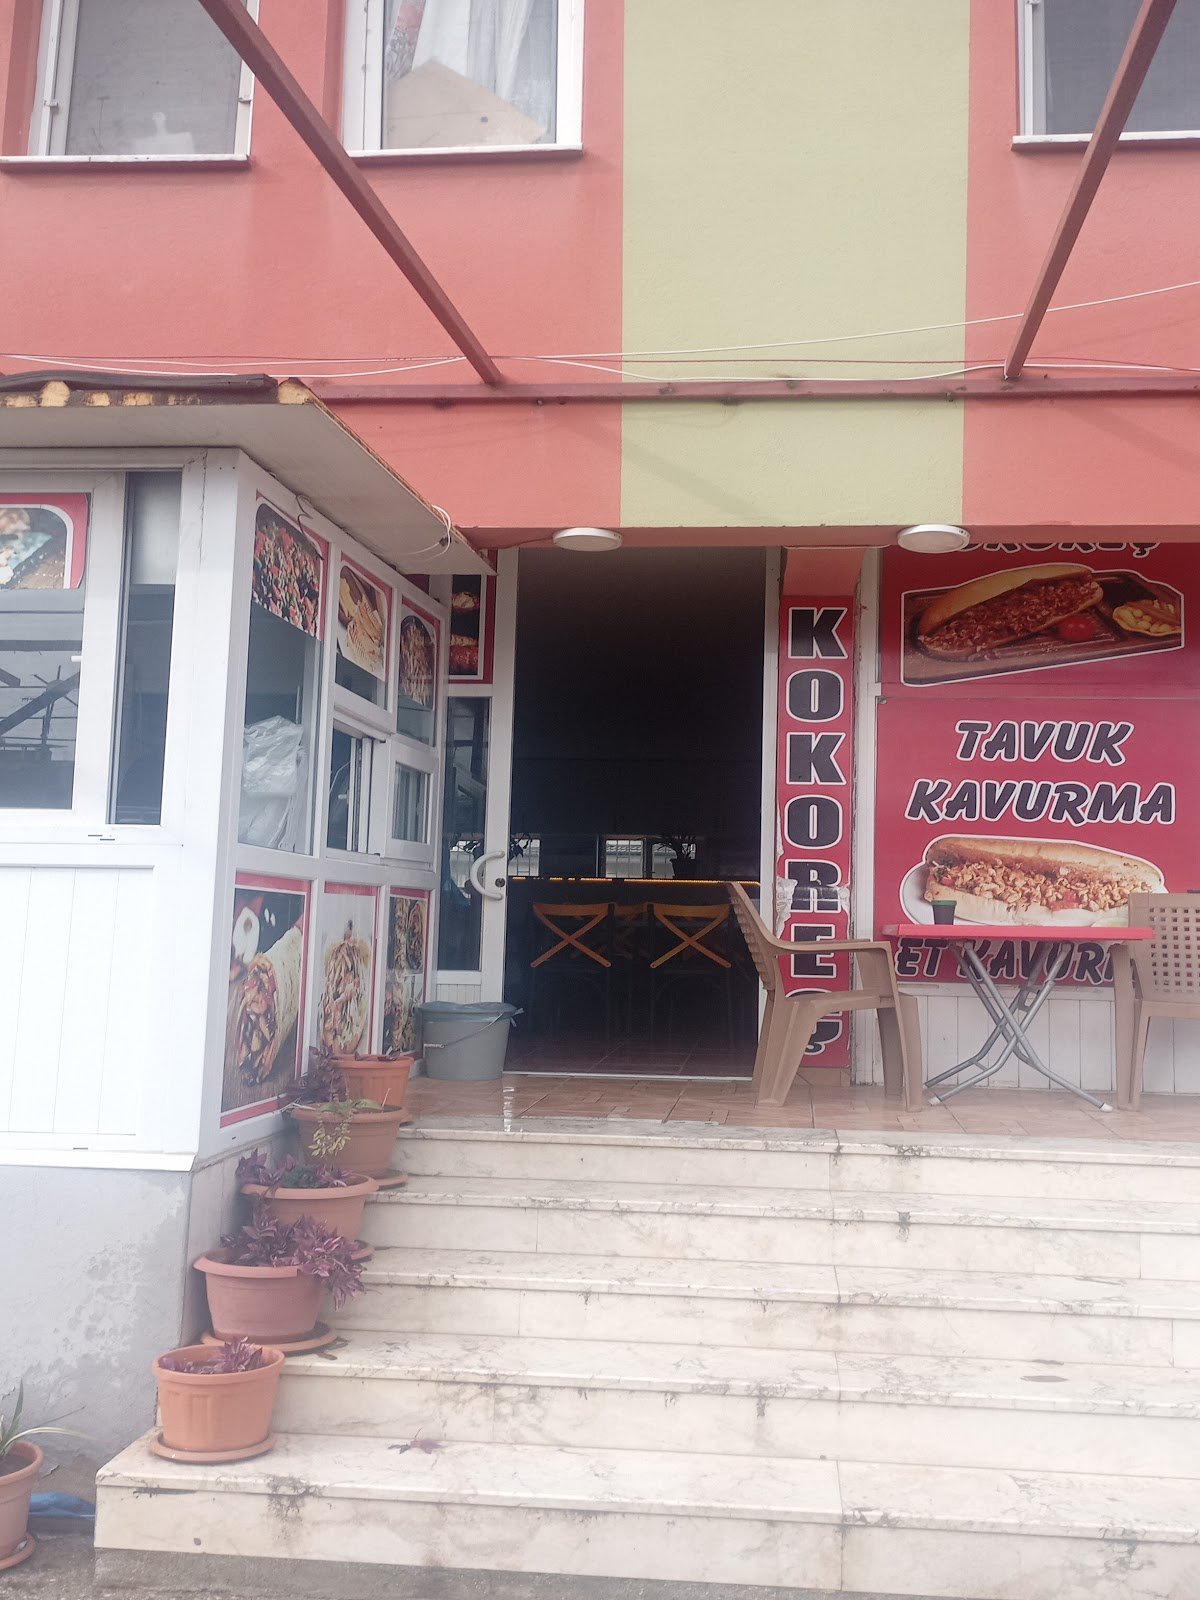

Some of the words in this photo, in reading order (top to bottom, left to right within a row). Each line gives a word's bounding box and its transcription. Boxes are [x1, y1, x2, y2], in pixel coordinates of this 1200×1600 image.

[955, 720, 1134, 766] TAVUK
[904, 779, 1176, 827] KAVURMA
[896, 937, 949, 977] ET
[959, 938, 1114, 985] KAVUR
